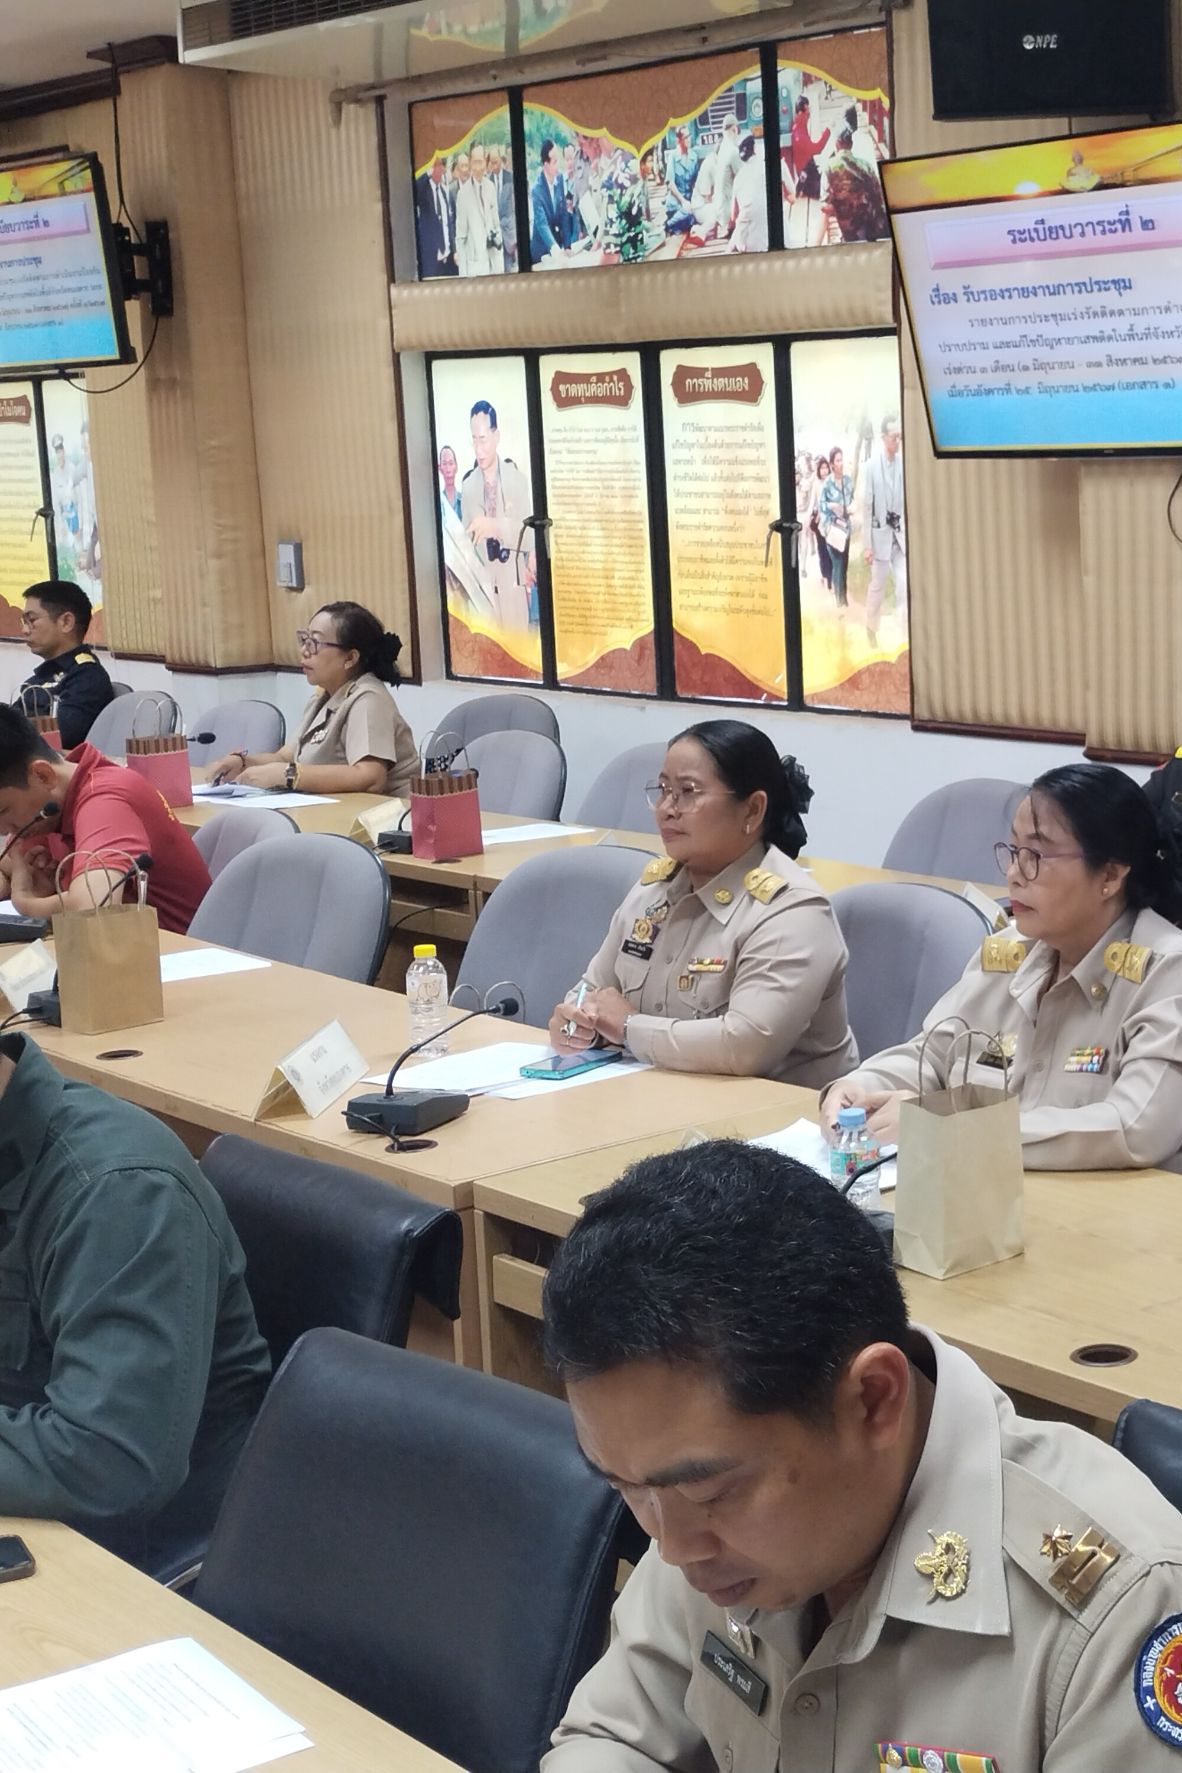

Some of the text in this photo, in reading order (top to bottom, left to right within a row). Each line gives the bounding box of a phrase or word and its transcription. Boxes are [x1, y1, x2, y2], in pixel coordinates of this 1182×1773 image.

[1007, 204, 1155, 245] ระเบียบวาระที่ ๒
[929, 276, 1133, 306] เรื่อง รับรองรายงานการประชุม
[558, 374, 625, 404] ขาดทุนคือกำไร
[685, 366, 749, 394] การพึ่งตนเอง
